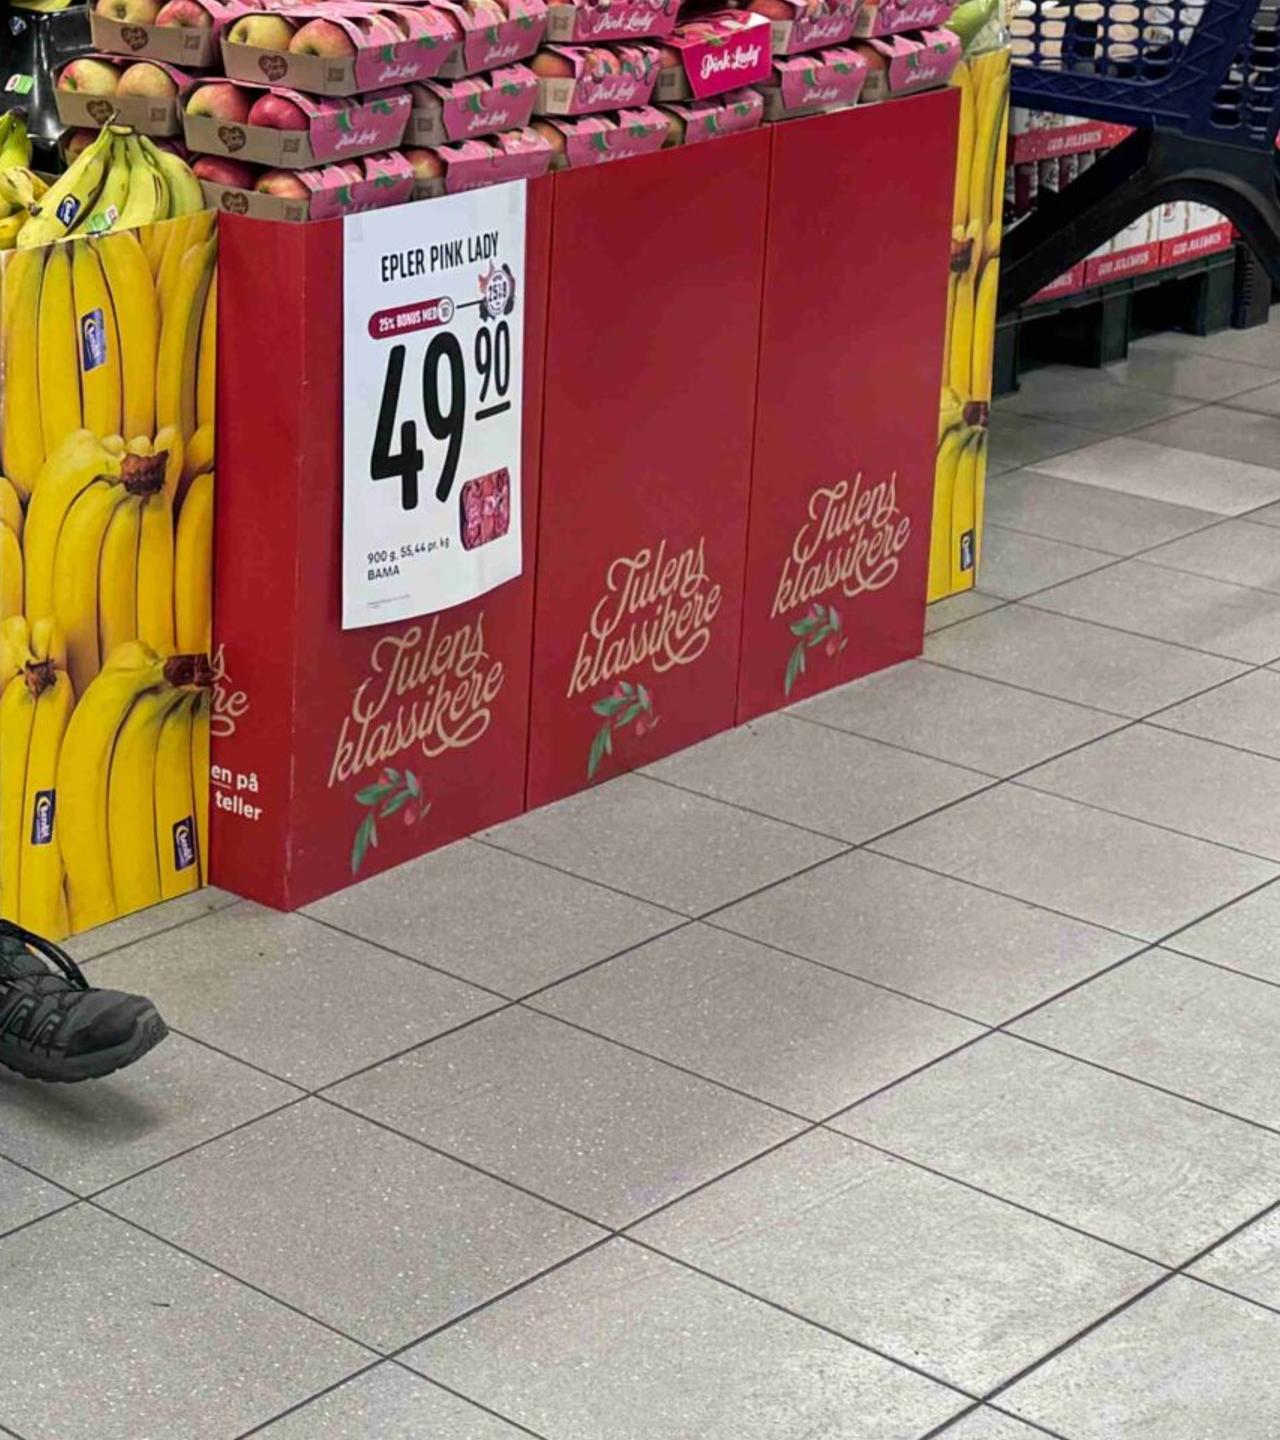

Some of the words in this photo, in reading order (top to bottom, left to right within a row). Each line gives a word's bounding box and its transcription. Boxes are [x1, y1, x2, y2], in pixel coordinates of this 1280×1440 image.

[593, 12, 624, 34] Pink
[624, 10, 656, 32] Lady
[700, 49, 731, 79] Pink
[731, 44, 762, 70] Lady
[381, 254, 426, 283] EPLER
[430, 241, 464, 270] PINK
[467, 231, 500, 262] LADY
[396, 310, 421, 328] BONUS
[370, 331, 467, 511] 49
[474, 320, 511, 403] 90
[795, 471, 901, 562] Julens
[367, 549, 388, 565] 900
[428, 539, 439, 554] pr.
[440, 535, 451, 549] kg
[367, 565, 401, 582] BAMA
[770, 510, 911, 620] klassikere
[591, 536, 709, 638] Julens
[567, 580, 723, 698] klassikere
[353, 612, 489, 722] Julens
[327, 656, 507, 789] klassikere
[215, 791, 263, 821] teller
[236, 773, 259, 793] på
